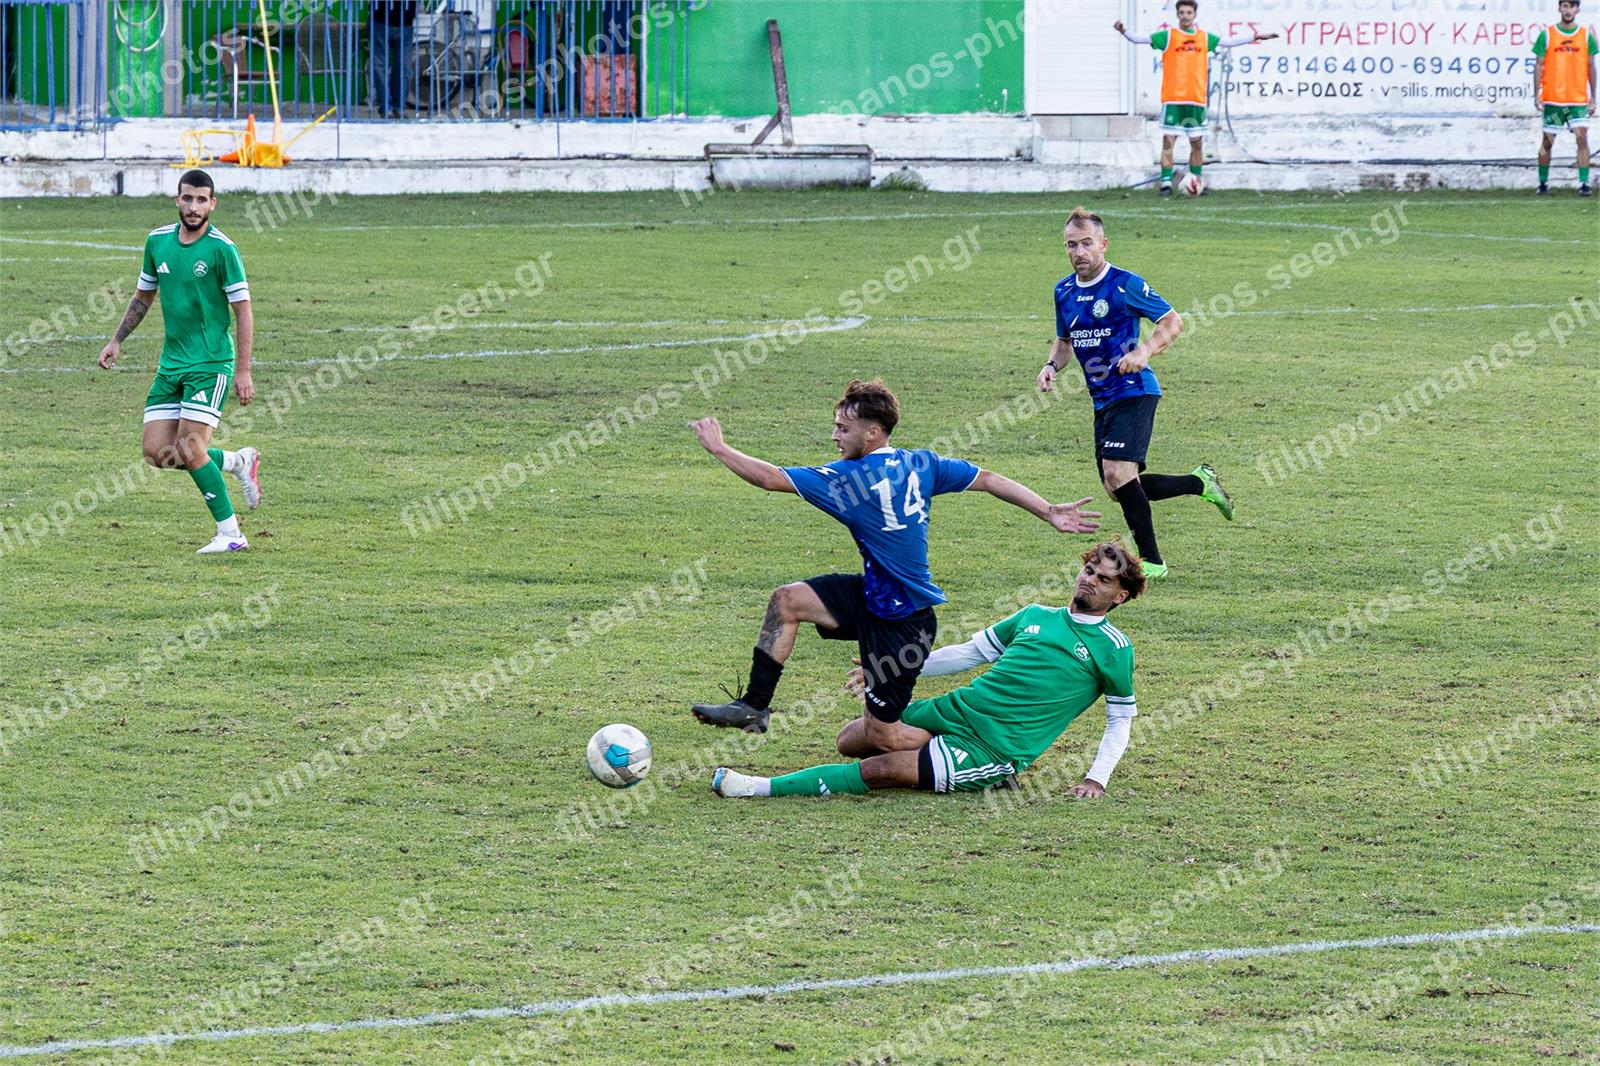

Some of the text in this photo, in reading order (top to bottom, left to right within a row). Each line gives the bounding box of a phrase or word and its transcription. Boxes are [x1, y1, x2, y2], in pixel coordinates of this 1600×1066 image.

[1209, 82, 1363, 97] ΑΡΙΤΣΑ-ΡΟΔΟΣ
[1094, 328, 1111, 337] GAS
[1073, 338, 1101, 347] SYSTEM
[870, 470, 927, 531] 14
